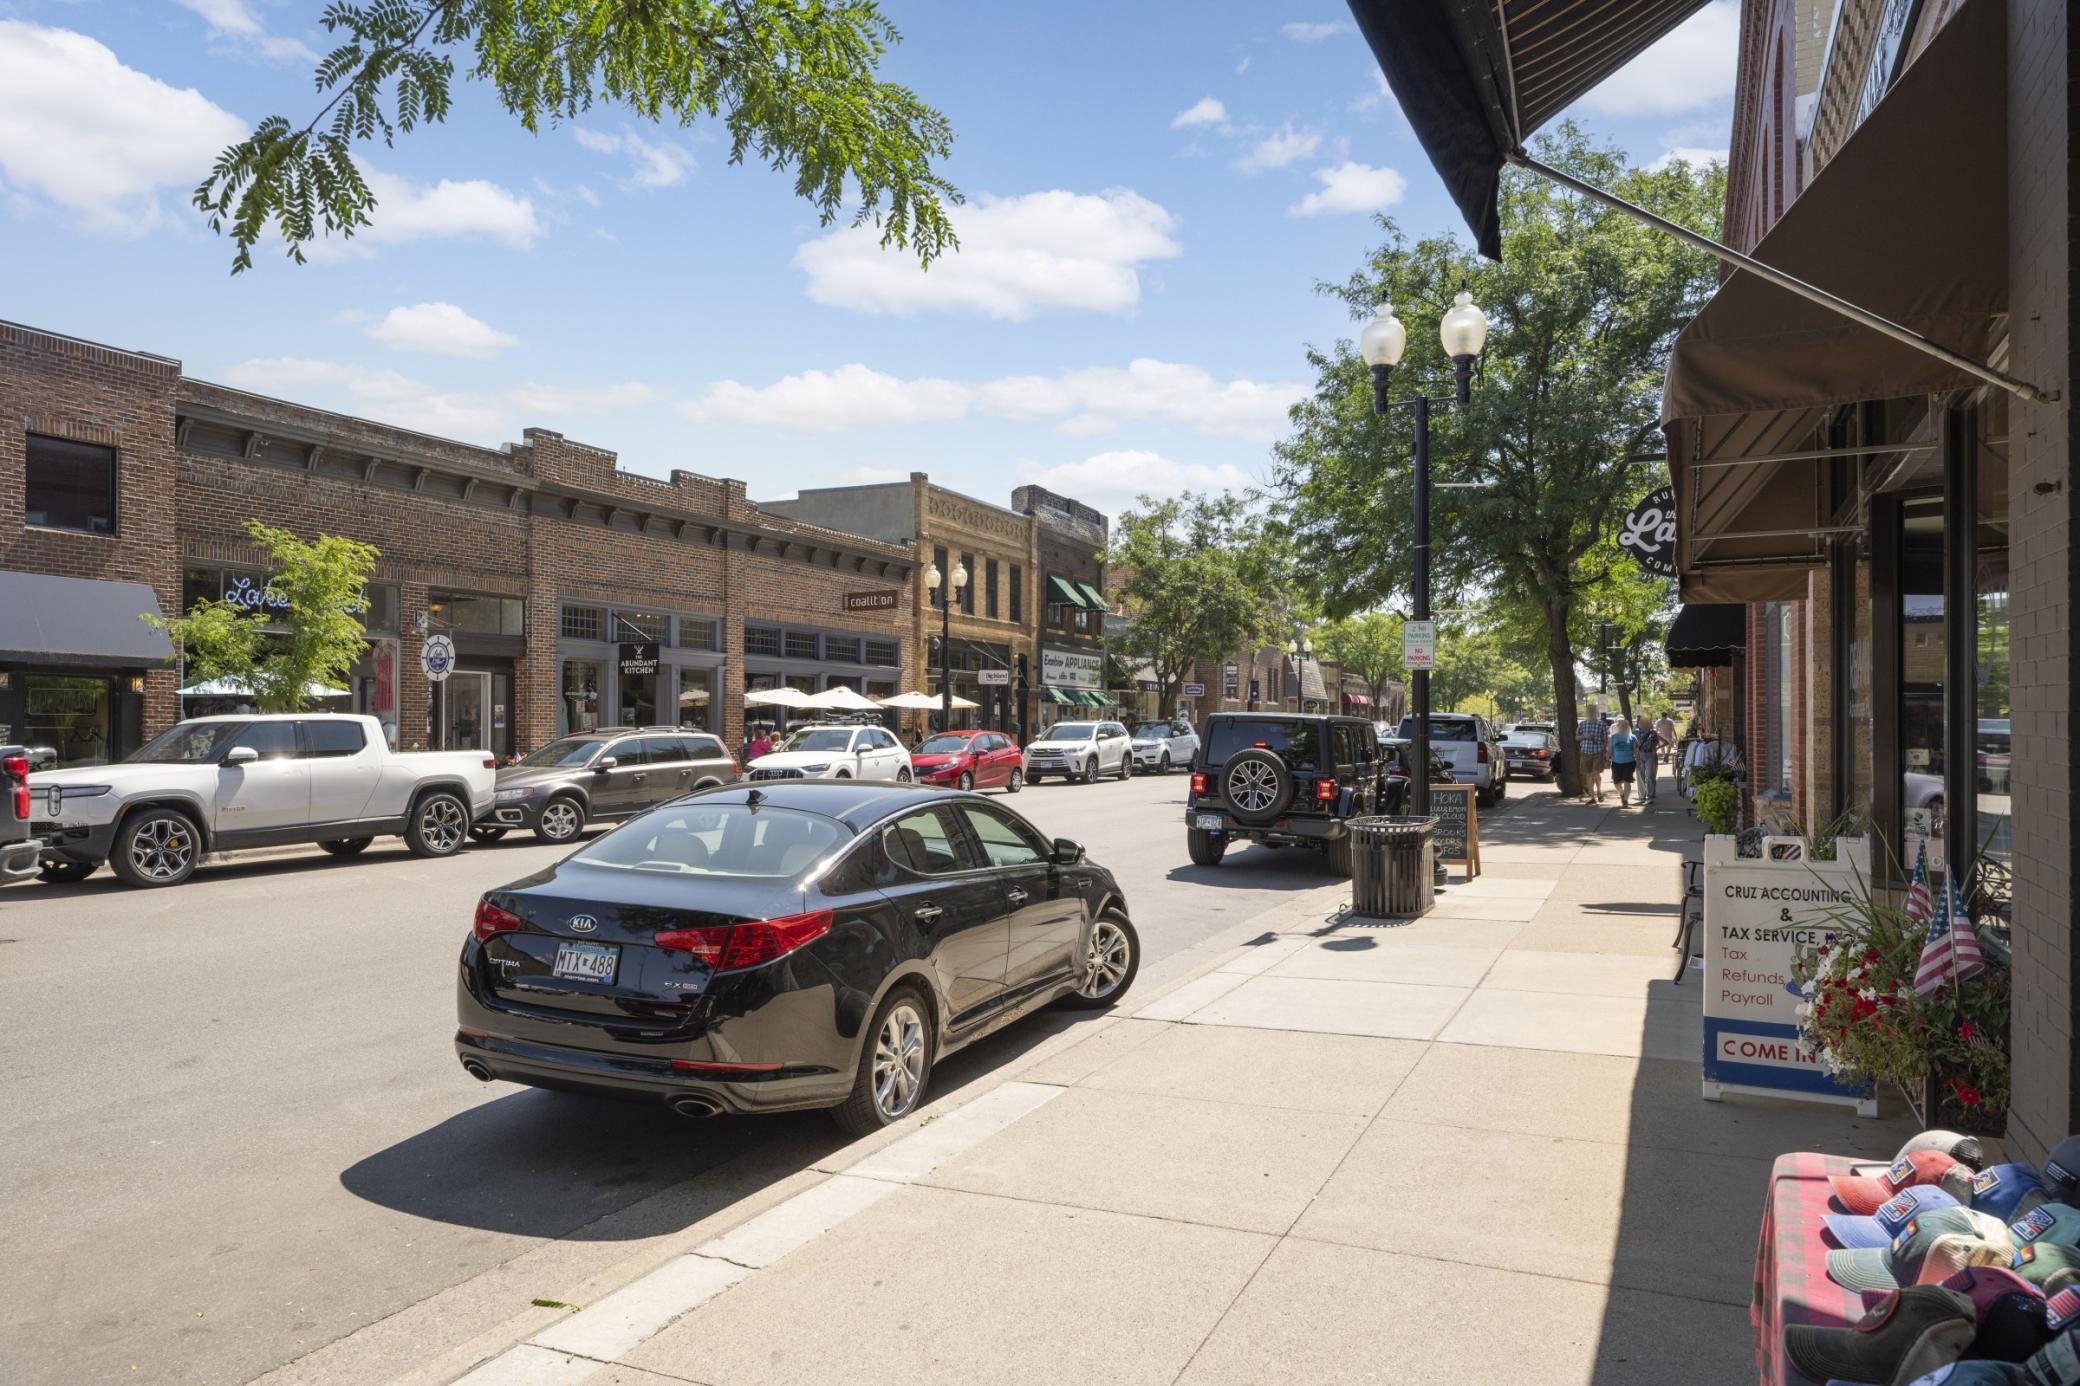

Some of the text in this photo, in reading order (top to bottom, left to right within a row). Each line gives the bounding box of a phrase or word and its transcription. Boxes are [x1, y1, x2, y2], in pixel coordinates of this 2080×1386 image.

[1619, 508, 1677, 553] La
[621, 659, 658, 667] ABUNDANT
[1064, 656, 1100, 671] APPLIANCE
[1434, 792, 1463, 804] HOKA
[1725, 885, 1851, 903] CRUZ ACCOUNTING
[1780, 908, 1793, 921] &
[572, 918, 592, 929] KIA
[1722, 926, 1750, 940] TAX
[1722, 947, 1748, 960] Tax
[556, 951, 614, 976] MTX 488
[1722, 990, 1773, 1006] Payroll
[1723, 1040, 1788, 1061] COME
